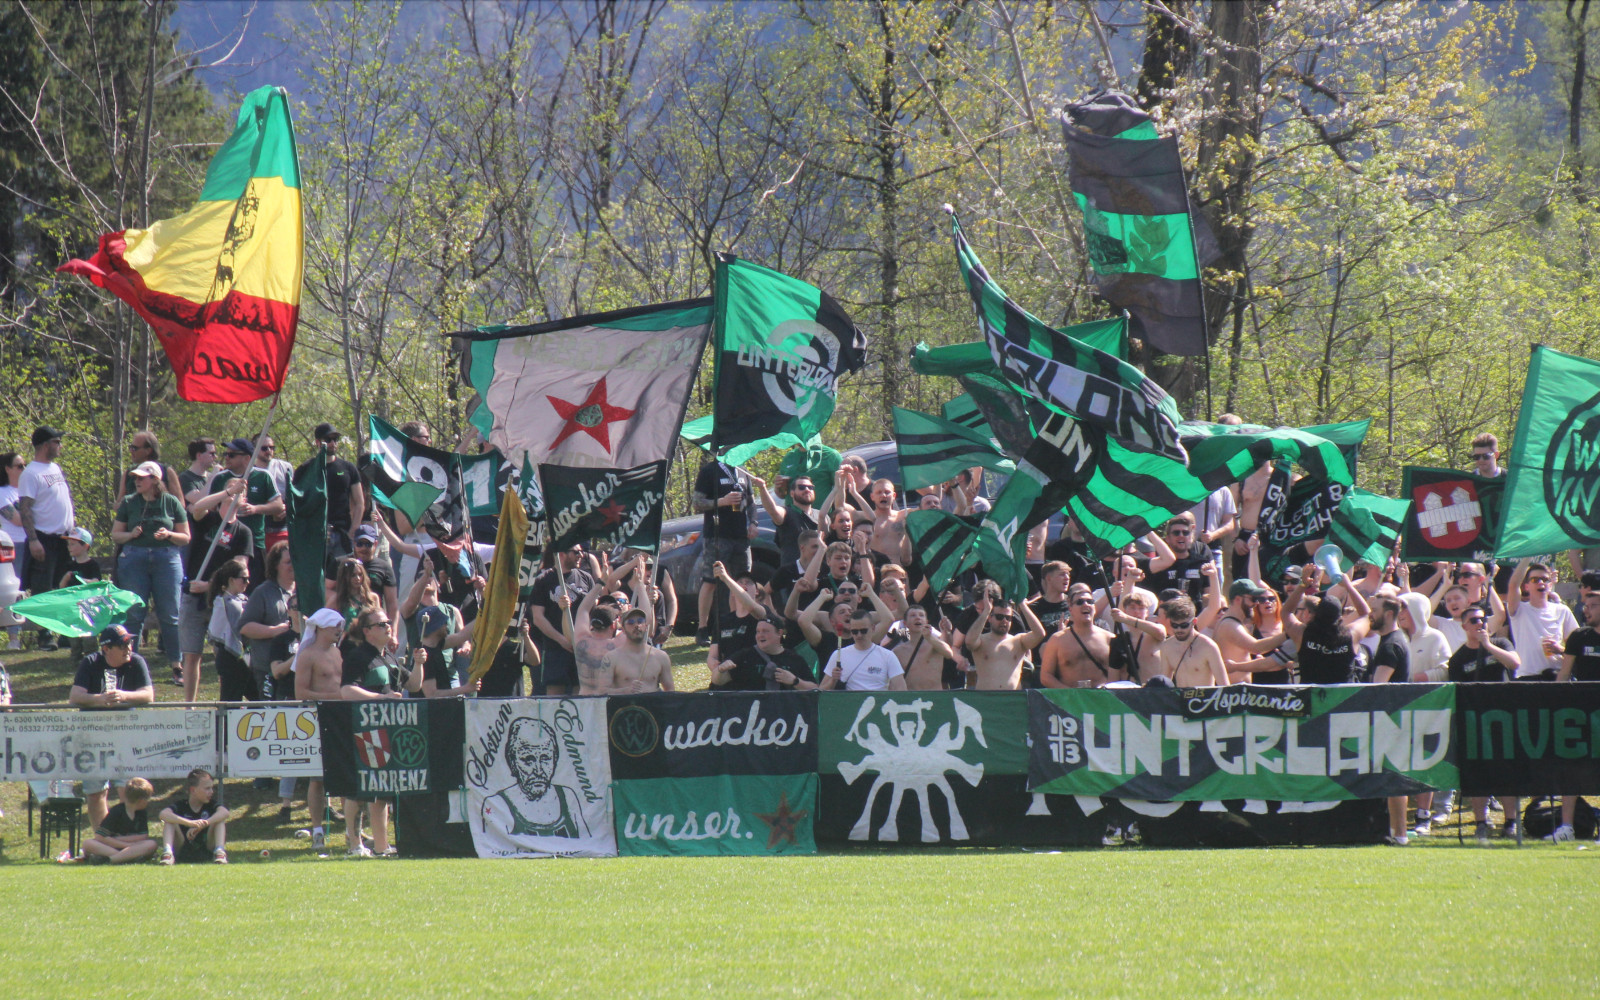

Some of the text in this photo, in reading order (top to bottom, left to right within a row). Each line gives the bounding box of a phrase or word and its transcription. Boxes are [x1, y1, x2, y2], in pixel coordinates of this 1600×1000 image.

[360, 702, 418, 727] SEXION
[1188, 686, 1305, 714] Aspirante
[33, 715, 64, 723] WÖRGL
[236, 710, 320, 742] GAS
[664, 699, 809, 750] wacker
[0, 735, 116, 774] hofer
[466, 702, 513, 790] Sektion
[553, 699, 603, 804] Edmund
[1082, 707, 1452, 777] UNTERLAND
[357, 768, 428, 792] TARRENZ
[624, 807, 754, 841] unser.
